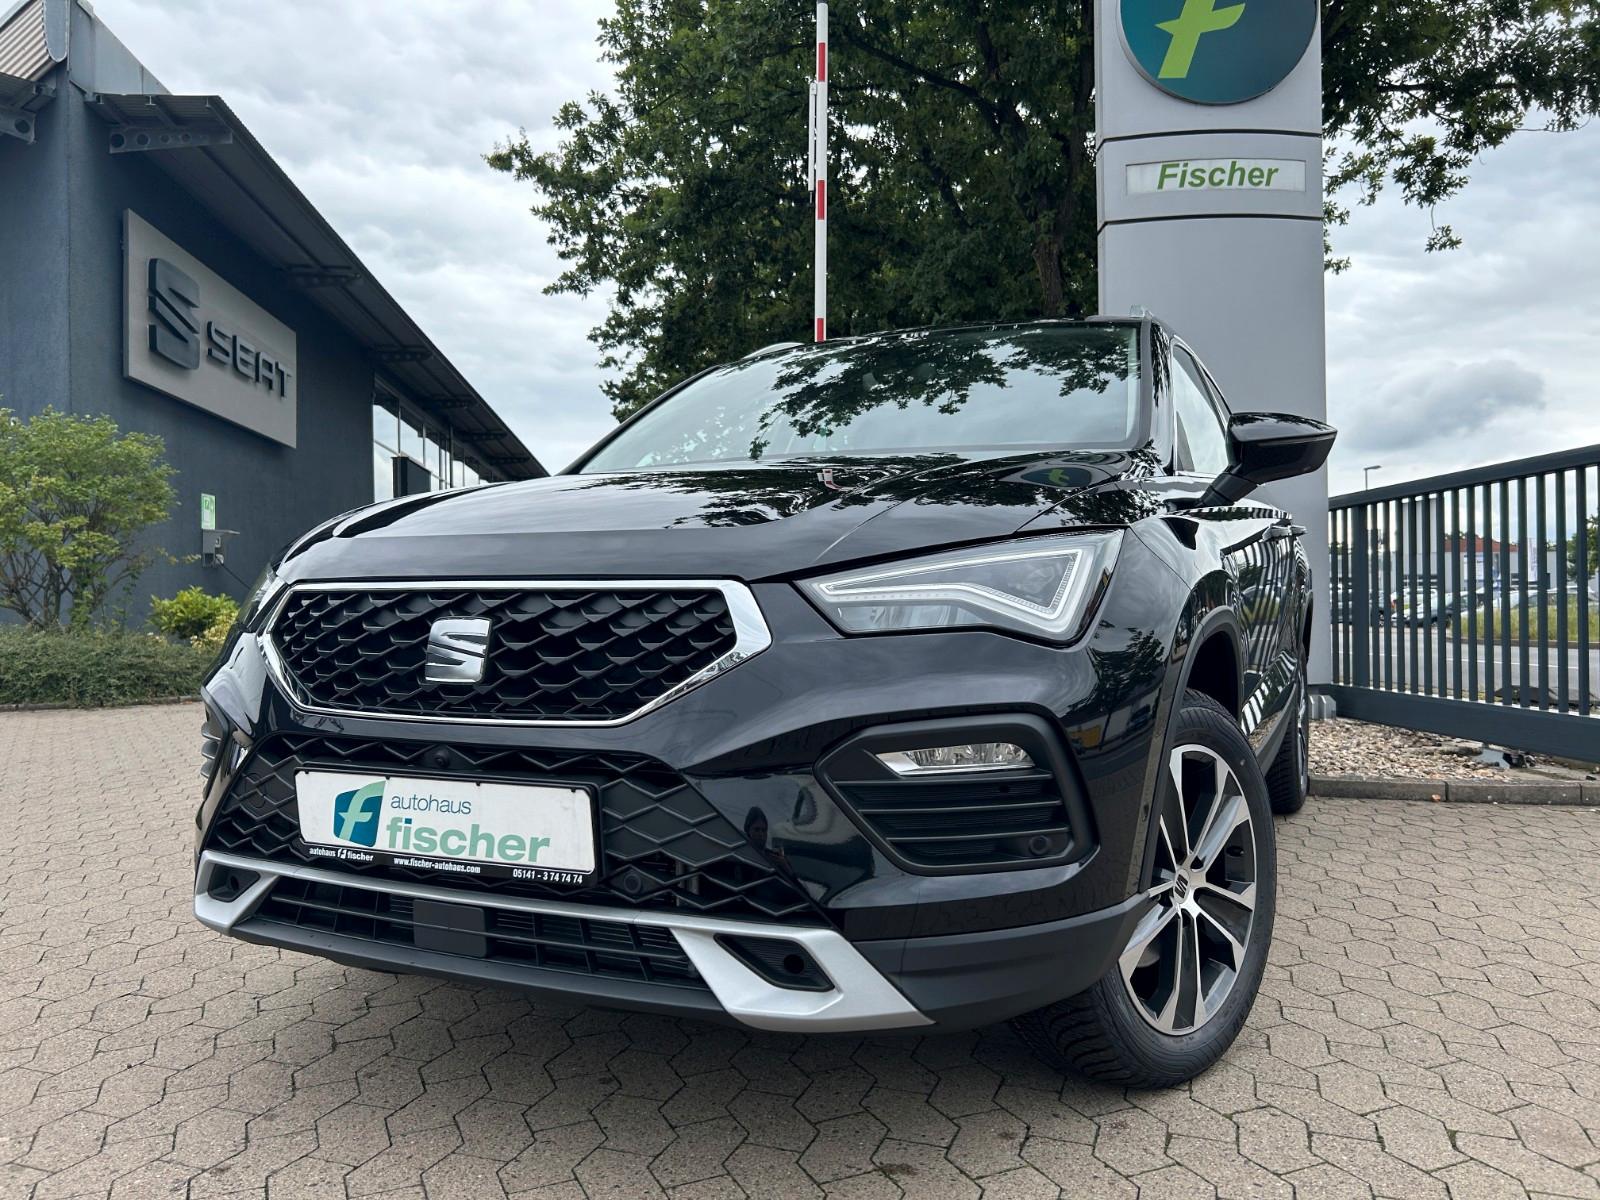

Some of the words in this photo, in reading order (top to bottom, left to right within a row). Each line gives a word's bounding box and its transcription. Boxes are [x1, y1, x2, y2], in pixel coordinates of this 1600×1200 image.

[1157, 161, 1279, 190] Fischer
[207, 320, 292, 398] SEAT
[390, 793, 472, 815] autohaus
[386, 816, 551, 863] fischer
[309, 846, 336, 858] autohaus
[347, 851, 374, 862] fischer
[393, 856, 481, 875] www.fischer-autohaus.com
[512, 867, 536, 880] 05141
